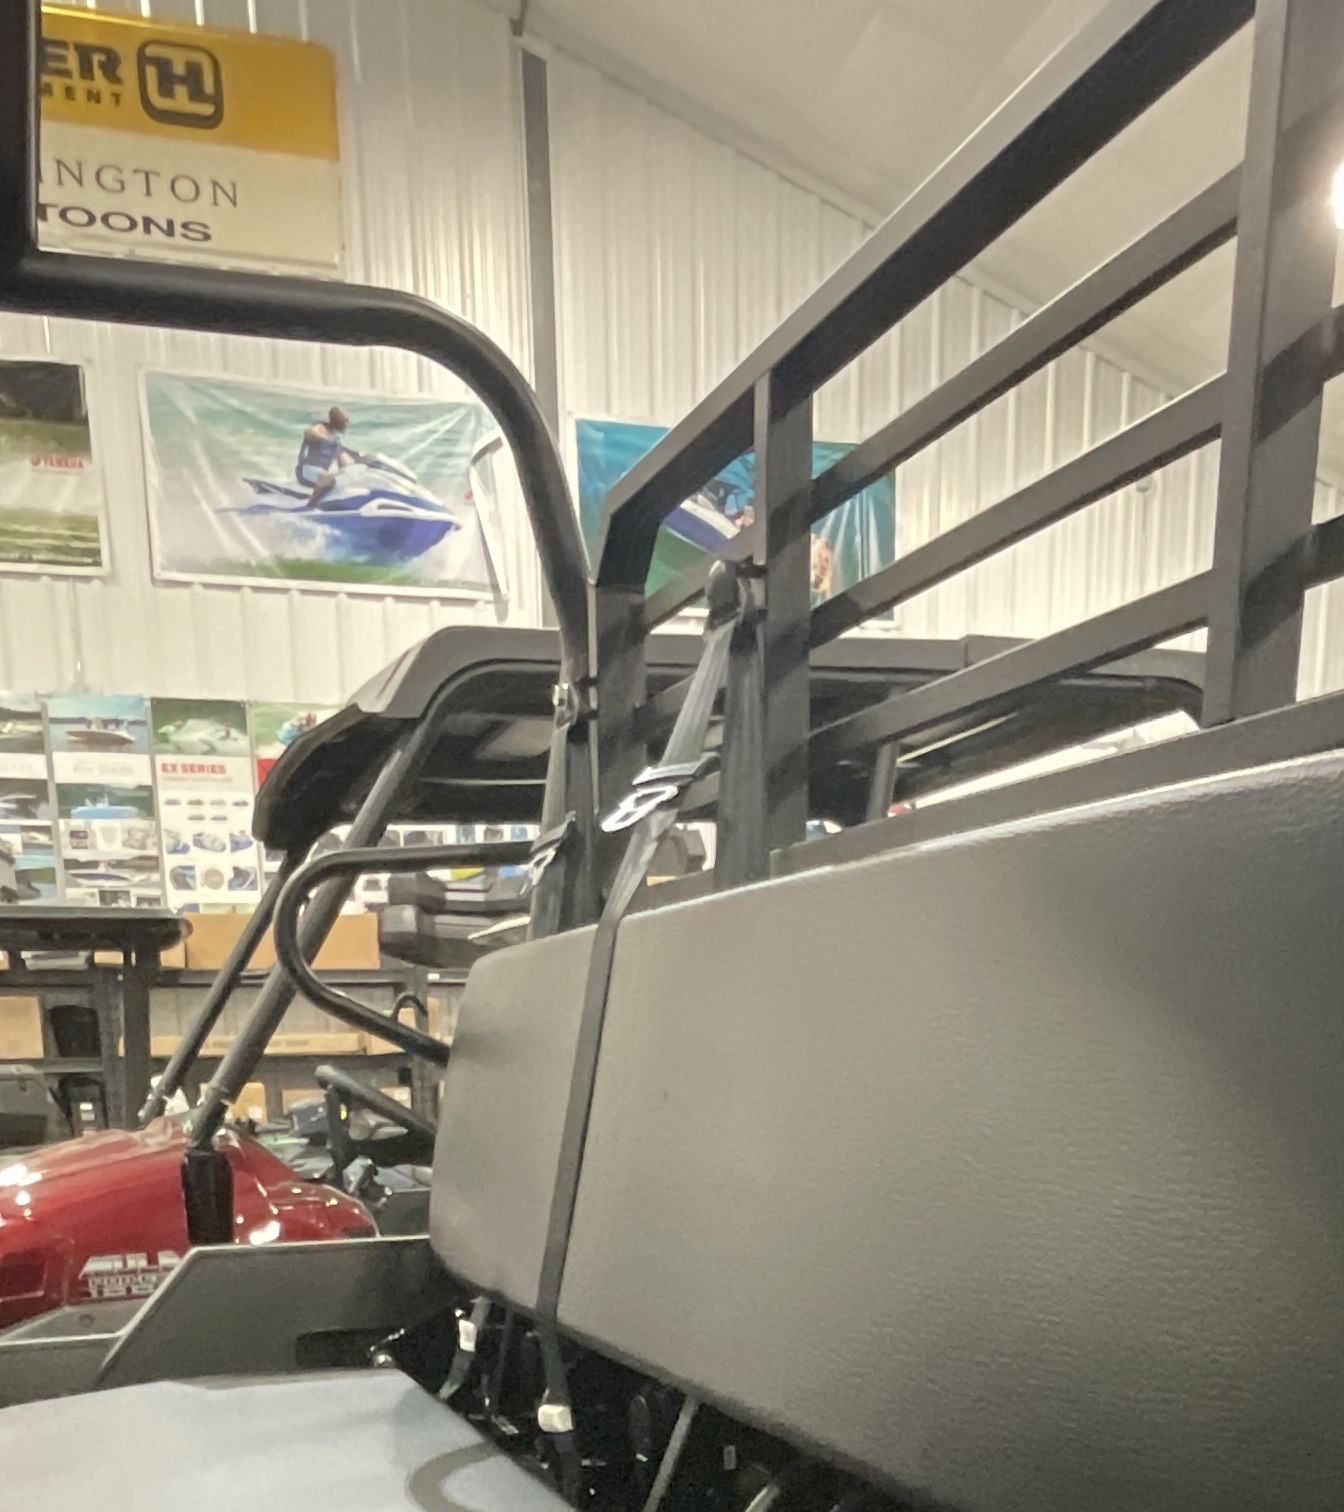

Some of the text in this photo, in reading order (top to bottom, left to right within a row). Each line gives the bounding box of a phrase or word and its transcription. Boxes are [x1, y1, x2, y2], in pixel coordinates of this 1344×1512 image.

[39, 158, 239, 208] NGTON
[161, 762, 227, 775] EX SERIES
